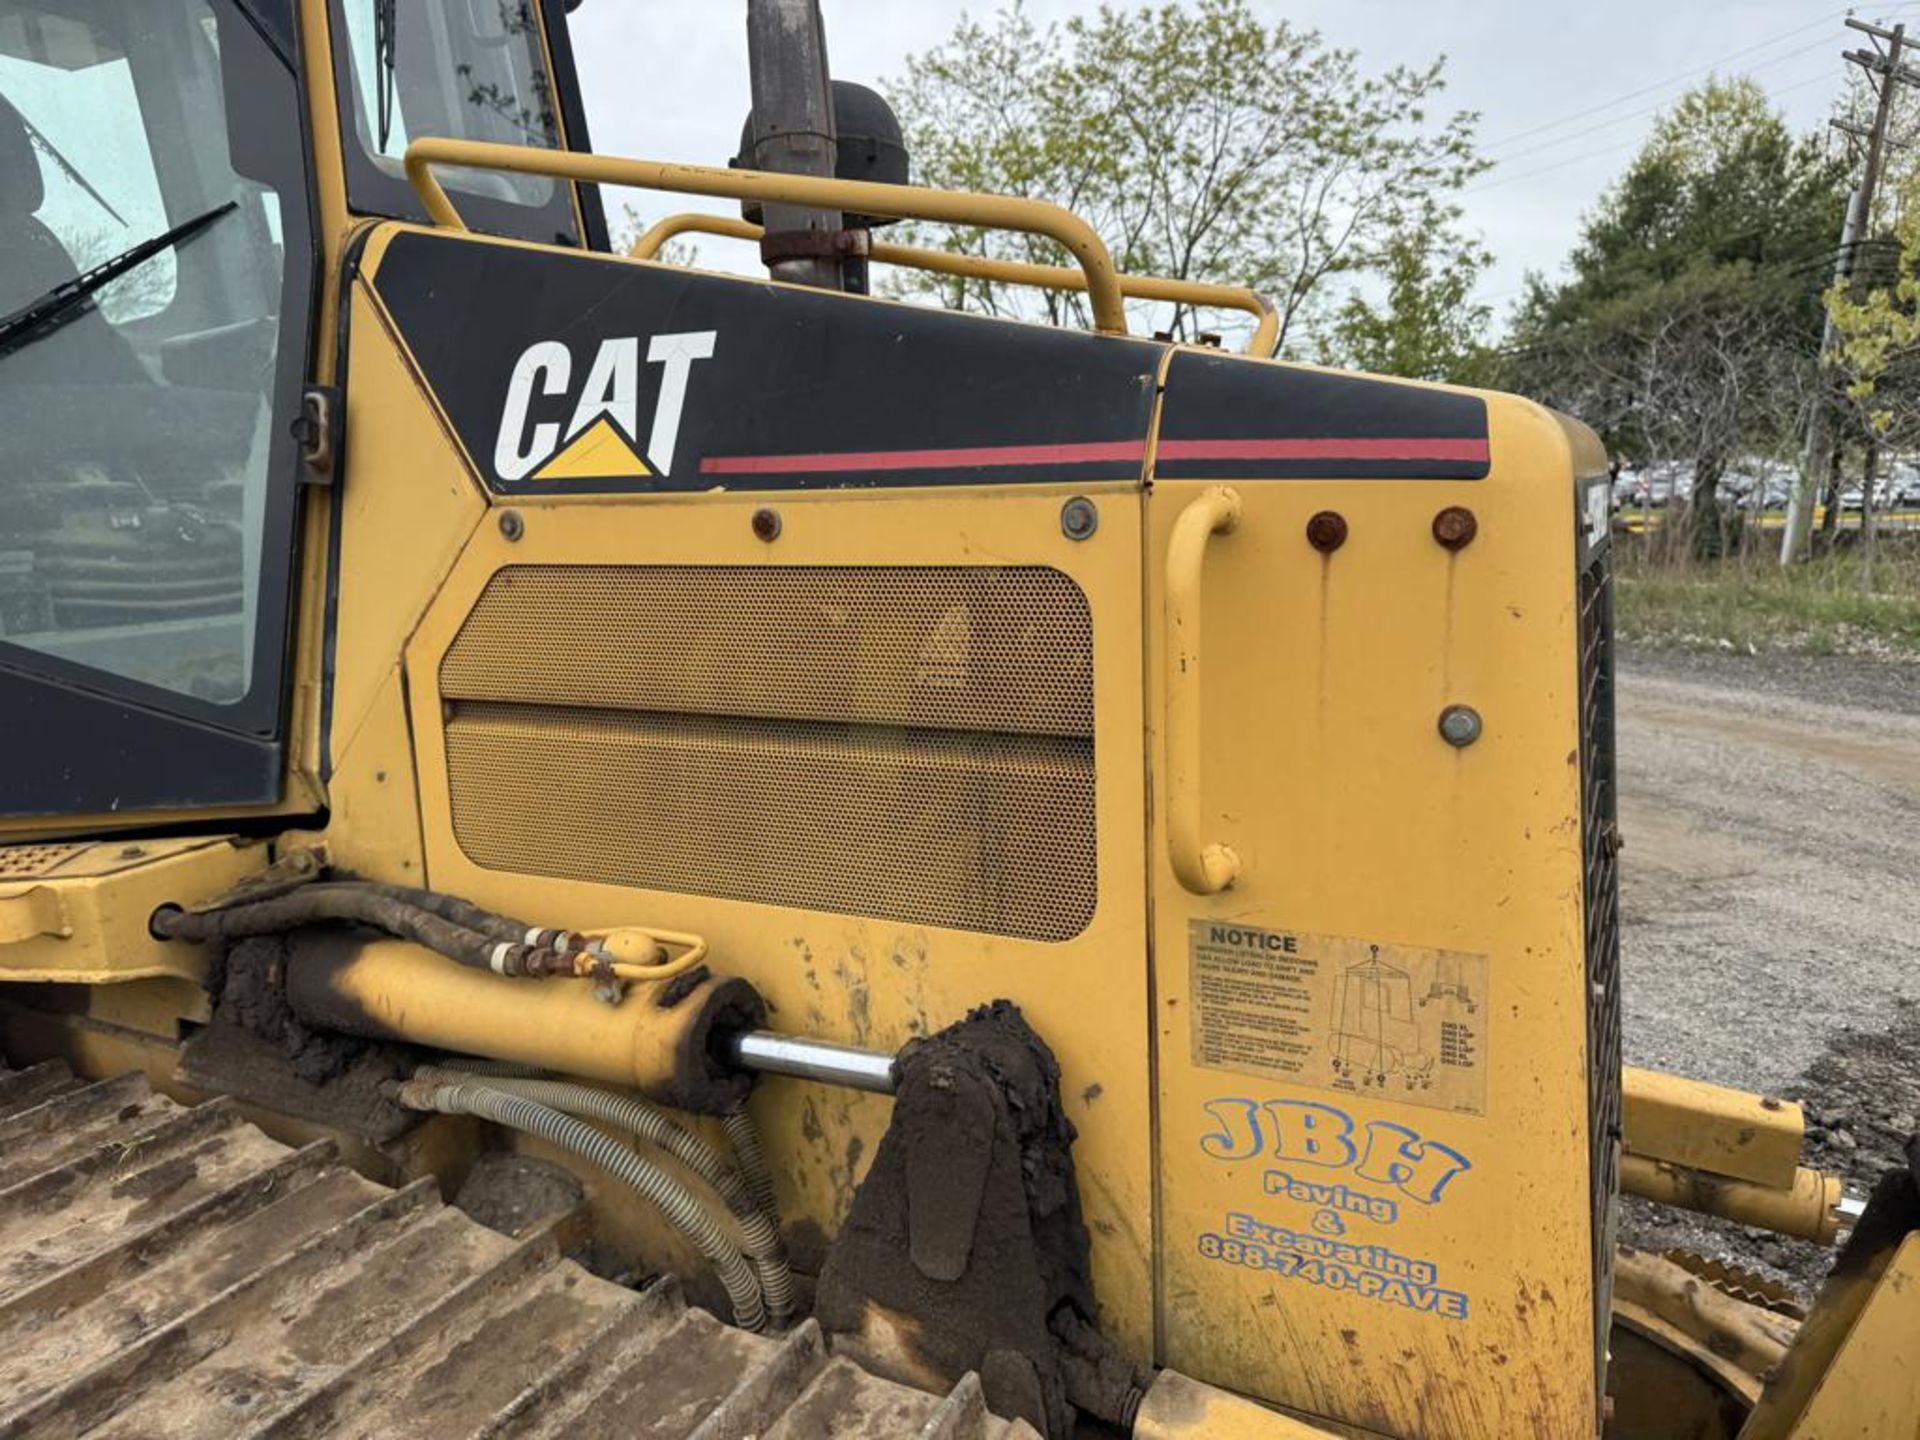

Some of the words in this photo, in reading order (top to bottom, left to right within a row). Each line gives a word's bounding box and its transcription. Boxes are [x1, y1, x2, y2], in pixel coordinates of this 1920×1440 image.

[494, 330, 717, 481] CAT
[1210, 927, 1297, 953] NOTICE
[1200, 1098, 1471, 1204] JBH
[1263, 1169, 1397, 1224] Paving
[1311, 1209, 1346, 1235] &
[1199, 1233, 1469, 1320] 888-740-PAVE
[1226, 1213, 1437, 1286] Excavating
